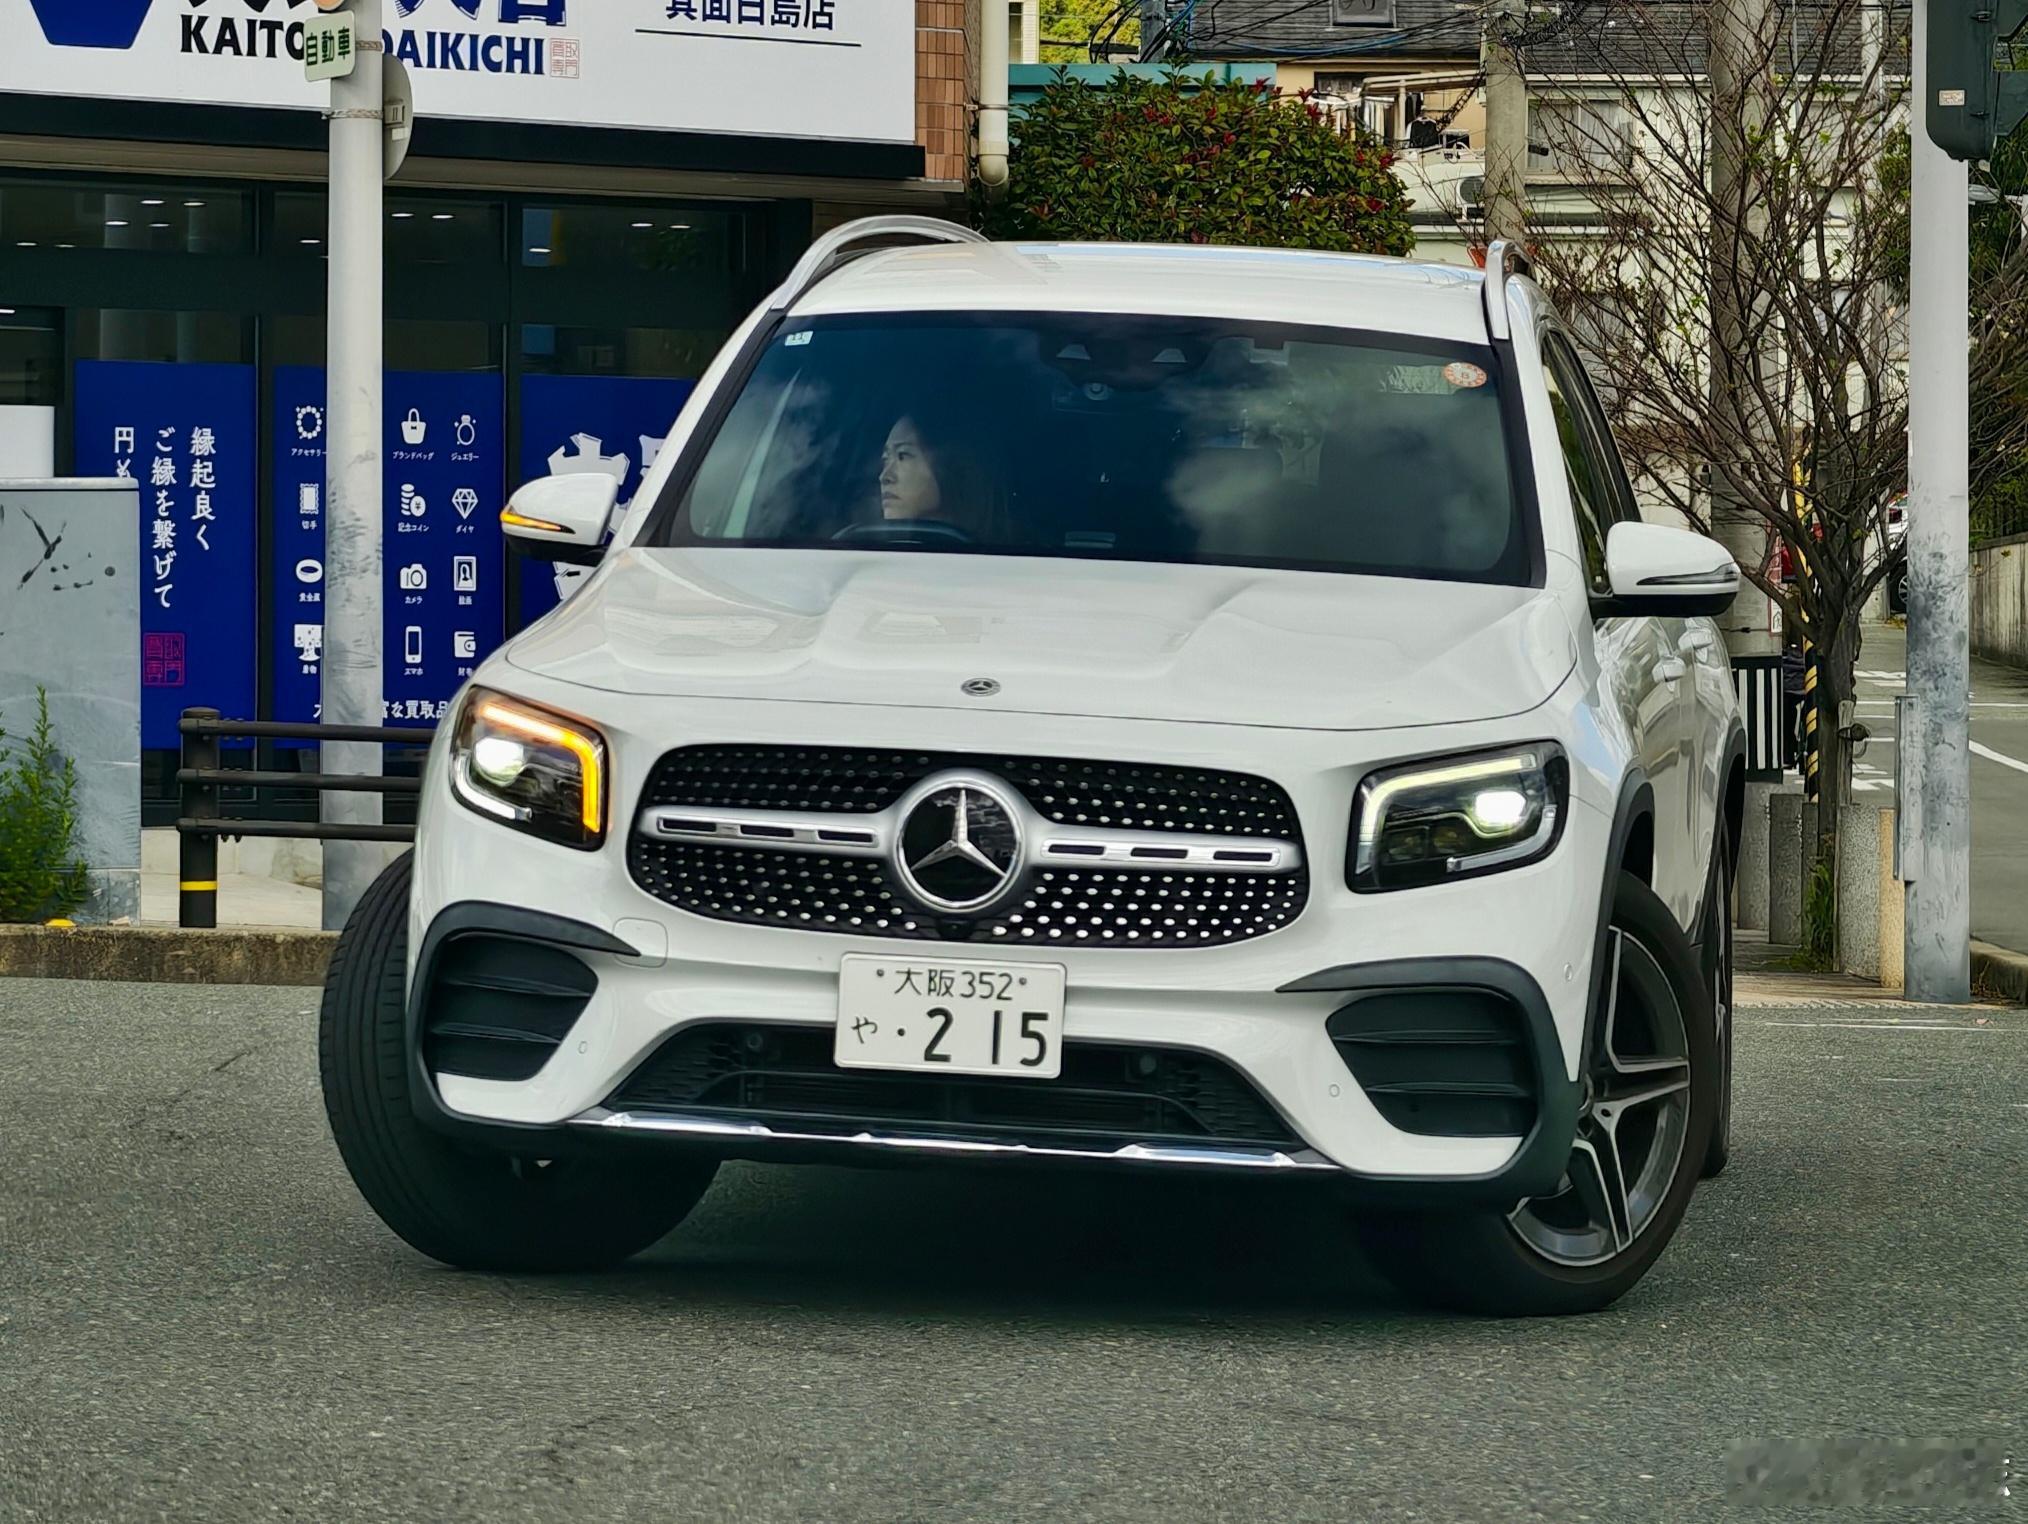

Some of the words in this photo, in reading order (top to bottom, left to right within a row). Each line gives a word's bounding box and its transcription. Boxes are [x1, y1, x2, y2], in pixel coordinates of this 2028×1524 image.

[181, 14, 305, 61] KAITO
[306, 26, 351, 66] 自動車
[190, 427, 216, 550] 縁起良く
[151, 427, 177, 607] ご縁を繋げて
[405, 595, 423, 605] カメラ
[404, 667, 424, 676] スマホ
[851, 1016, 878, 1044] や
